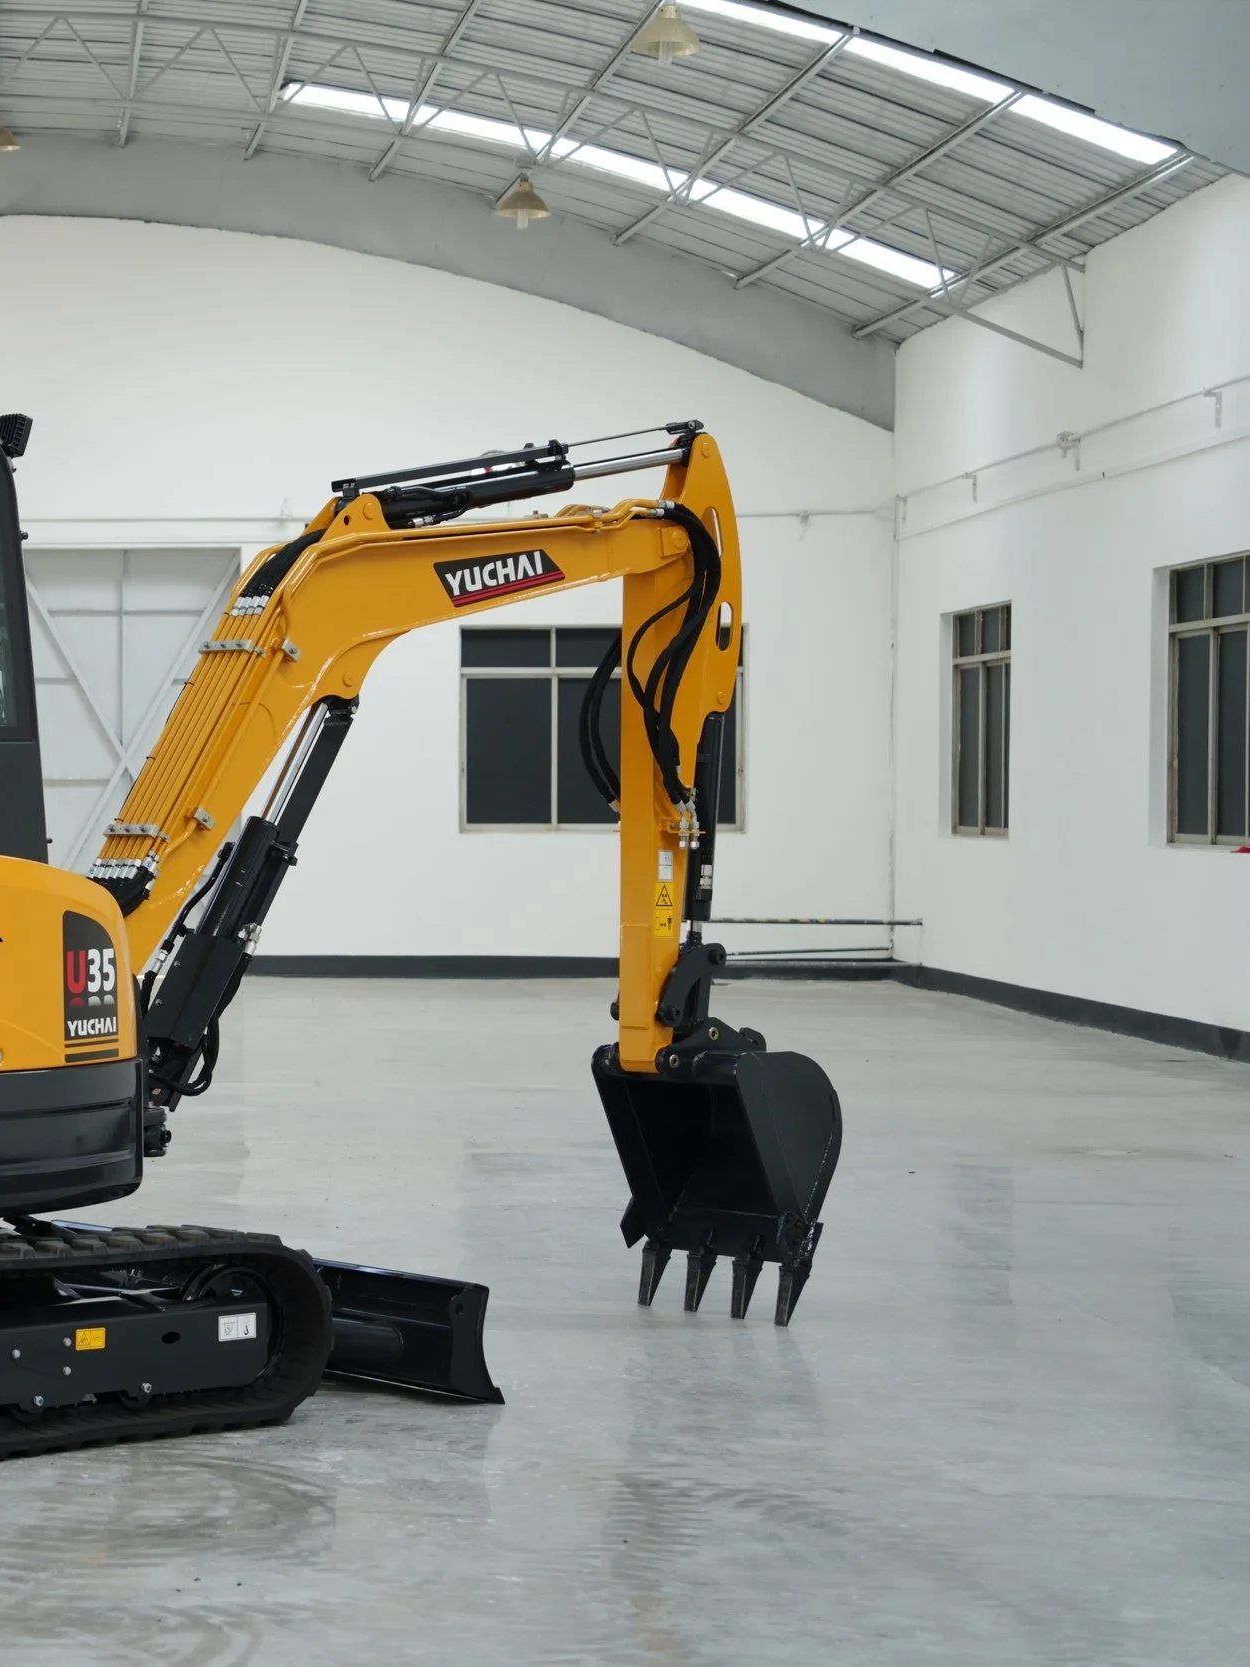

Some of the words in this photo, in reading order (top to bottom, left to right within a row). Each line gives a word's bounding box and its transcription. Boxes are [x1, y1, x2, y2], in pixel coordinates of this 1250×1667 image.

[445, 551, 543, 596] YUCHAI
[66, 948, 116, 994] U35
[67, 1016, 117, 1037] YUCHAI
